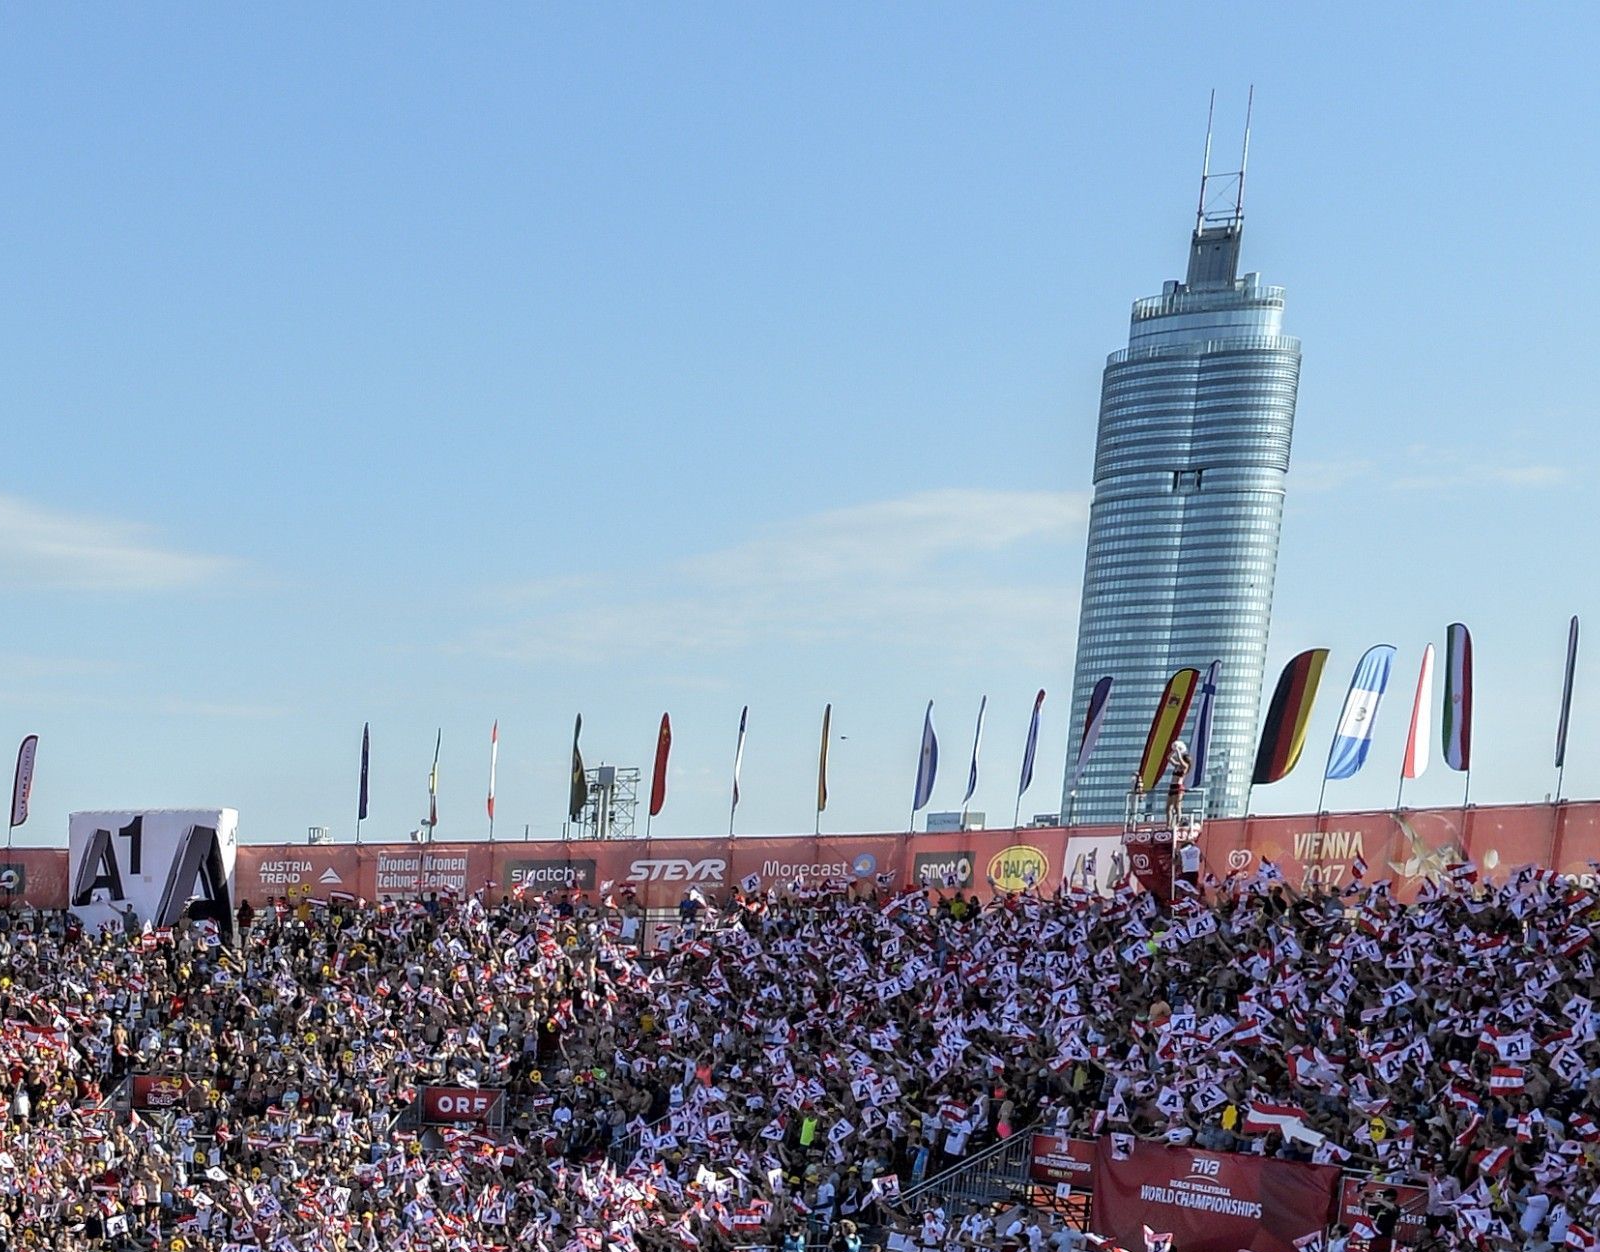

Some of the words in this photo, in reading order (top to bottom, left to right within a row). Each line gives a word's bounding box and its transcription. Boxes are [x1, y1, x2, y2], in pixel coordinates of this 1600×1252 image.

[1293, 831, 1363, 860] VIENNA
[260, 861, 313, 873] AUSTRIA
[378, 856, 418, 872] Kronen
[424, 854, 465, 871] Kronen
[626, 859, 726, 881] STEYR
[762, 860, 848, 878] Morecast
[259, 873, 300, 884] TREND
[377, 872, 417, 889] Zeitung
[511, 867, 575, 883] swatch
[438, 1096, 487, 1113] ORF
[1191, 1158, 1221, 1176] FIVB
[1141, 1185, 1174, 1204] WORLD
[1175, 1190, 1263, 1220] CHAMPIONSHIPS
